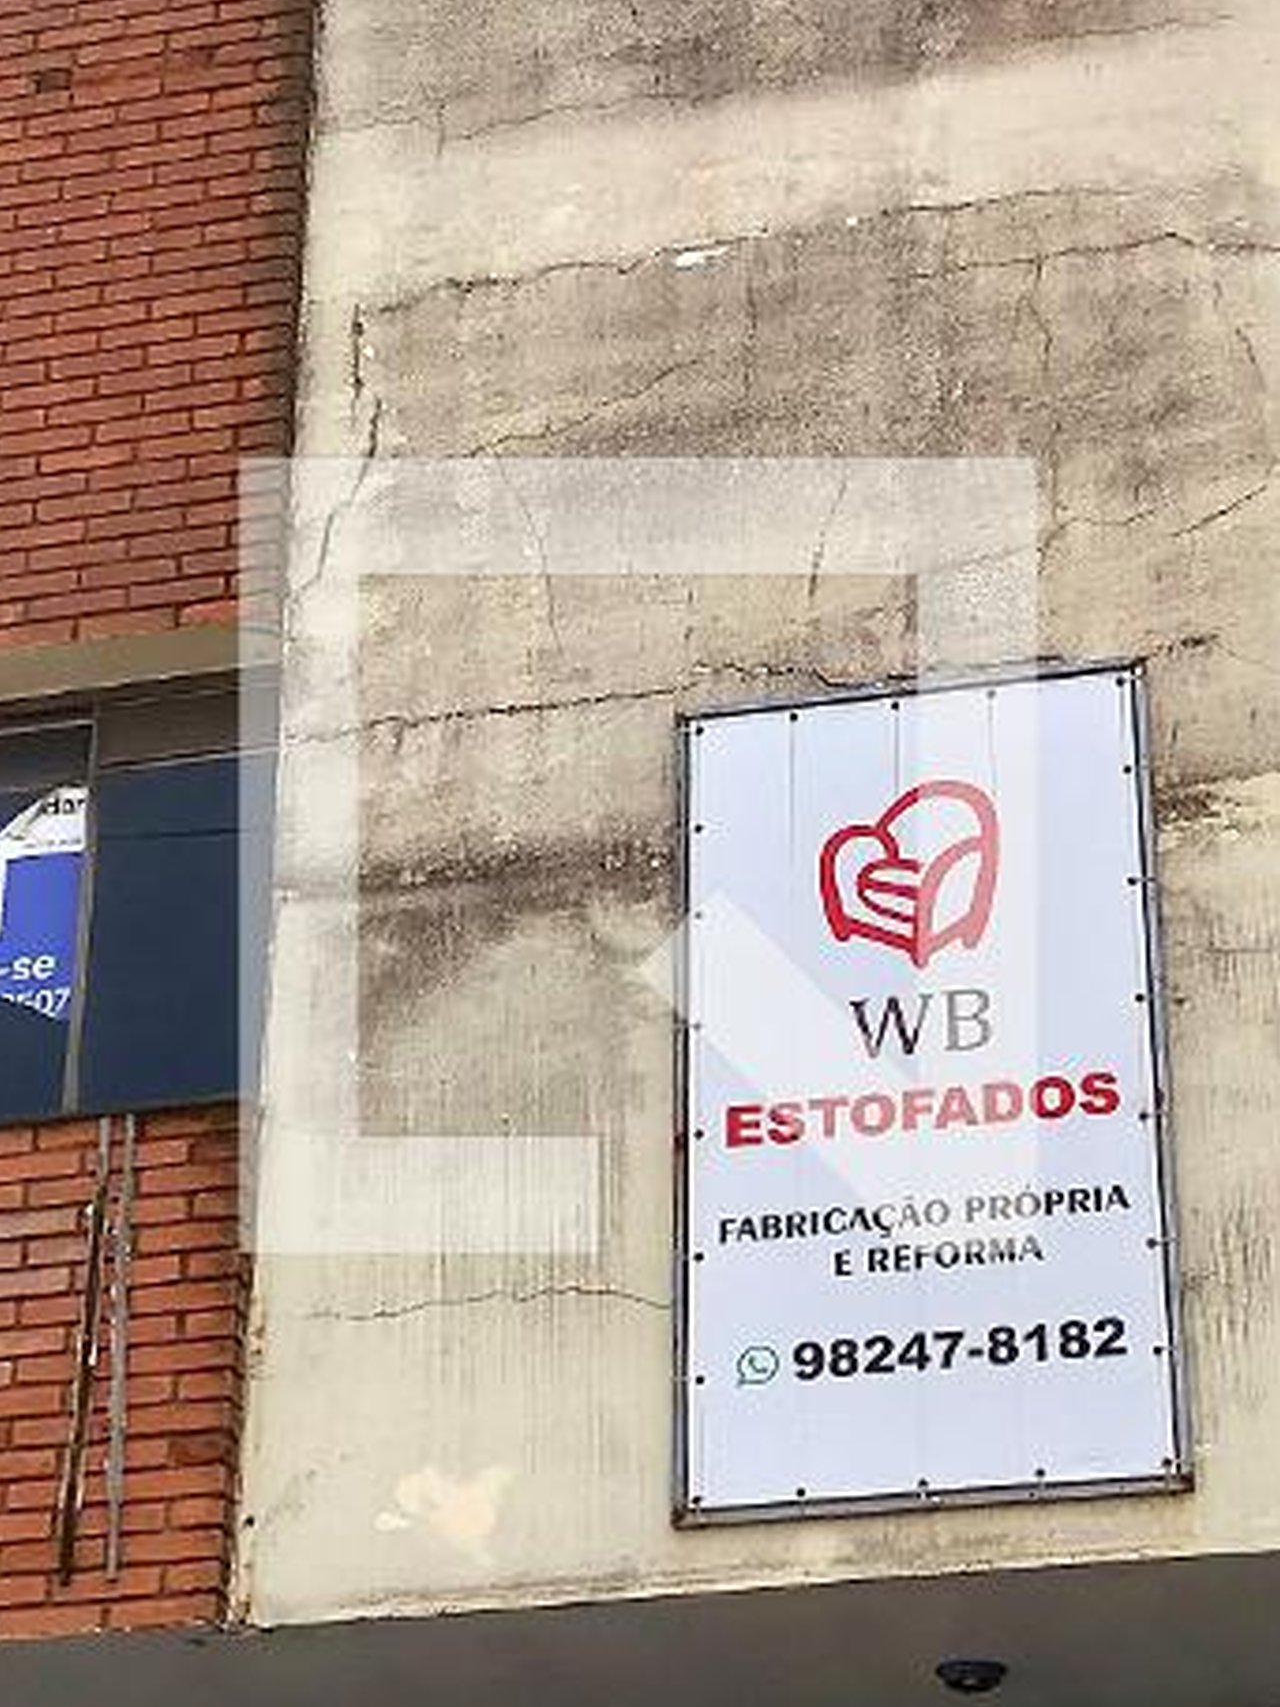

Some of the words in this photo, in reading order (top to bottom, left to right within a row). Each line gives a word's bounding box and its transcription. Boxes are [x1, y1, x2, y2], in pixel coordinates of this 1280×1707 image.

[849, 987, 993, 1059] WB
[724, 1071, 1121, 1149] ESTOFADOS
[718, 1195, 951, 1244] FABRICAÇÃO
[966, 1184, 1131, 1224] PRÓPRIA
[833, 1249, 853, 1276] E
[867, 1234, 1045, 1274] REFORMA
[792, 1316, 1128, 1383] 98247-8182
